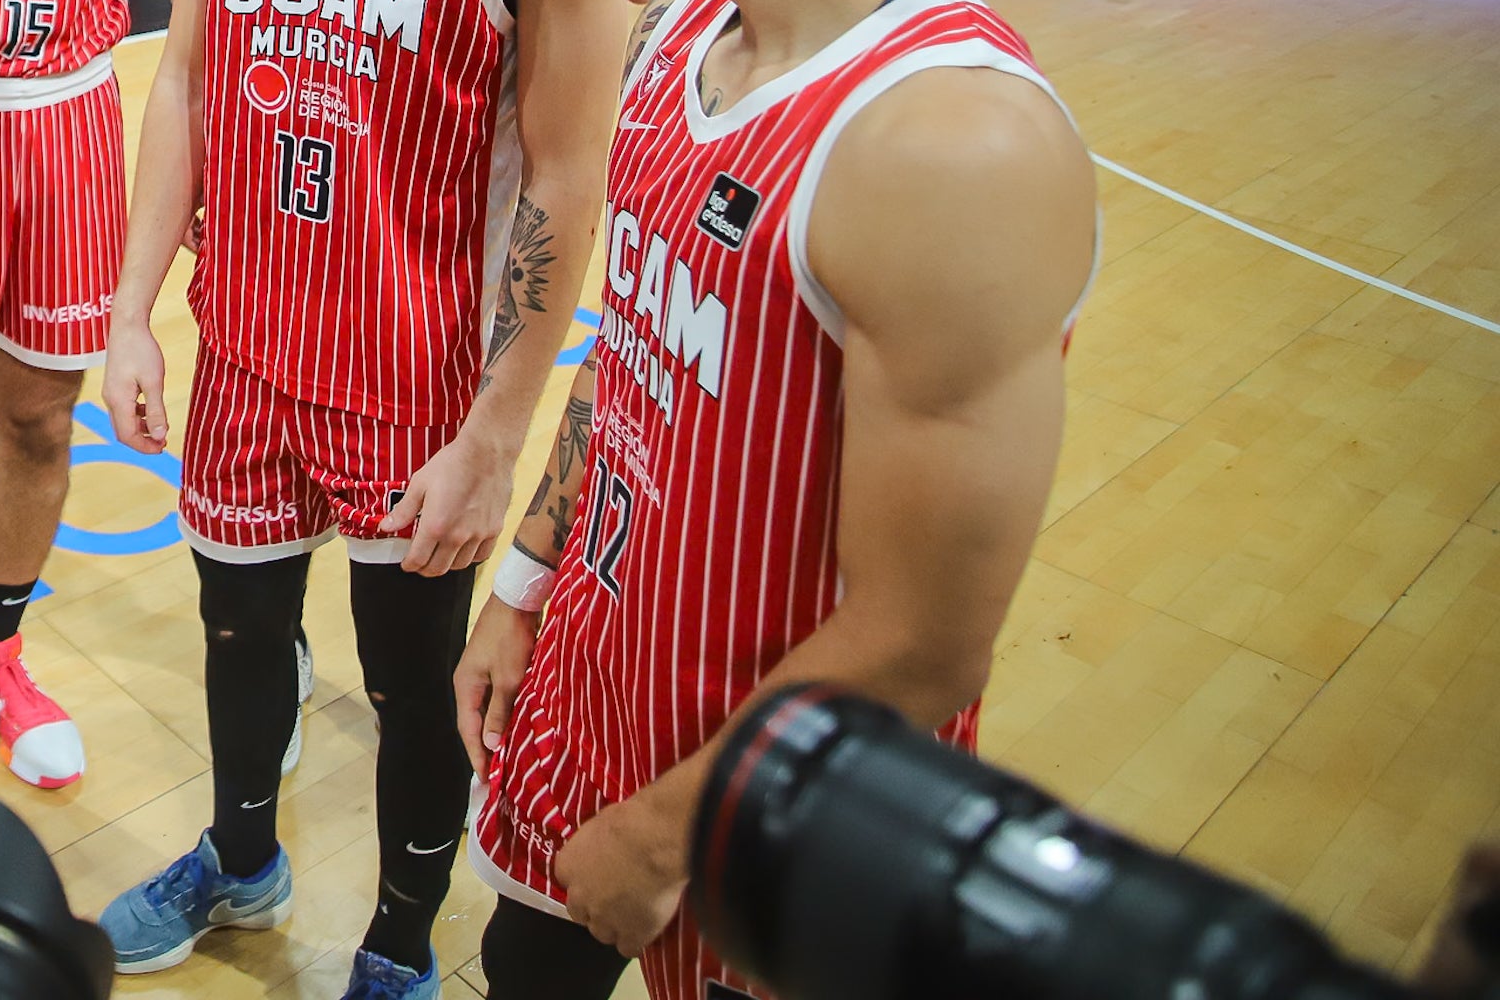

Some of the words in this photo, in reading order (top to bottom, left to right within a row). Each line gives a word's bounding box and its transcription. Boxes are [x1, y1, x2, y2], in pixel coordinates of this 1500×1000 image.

[250, 24, 378, 82] MURCIA
[298, 103, 320, 120] DE
[324, 108, 370, 137] MURCIA
[274, 130, 335, 225] 13
[605, 199, 727, 400] CAM
[599, 302, 674, 427] MURCIA
[606, 429, 623, 458] DE
[187, 487, 300, 524] INVERSUS
[582, 454, 634, 604] 12
